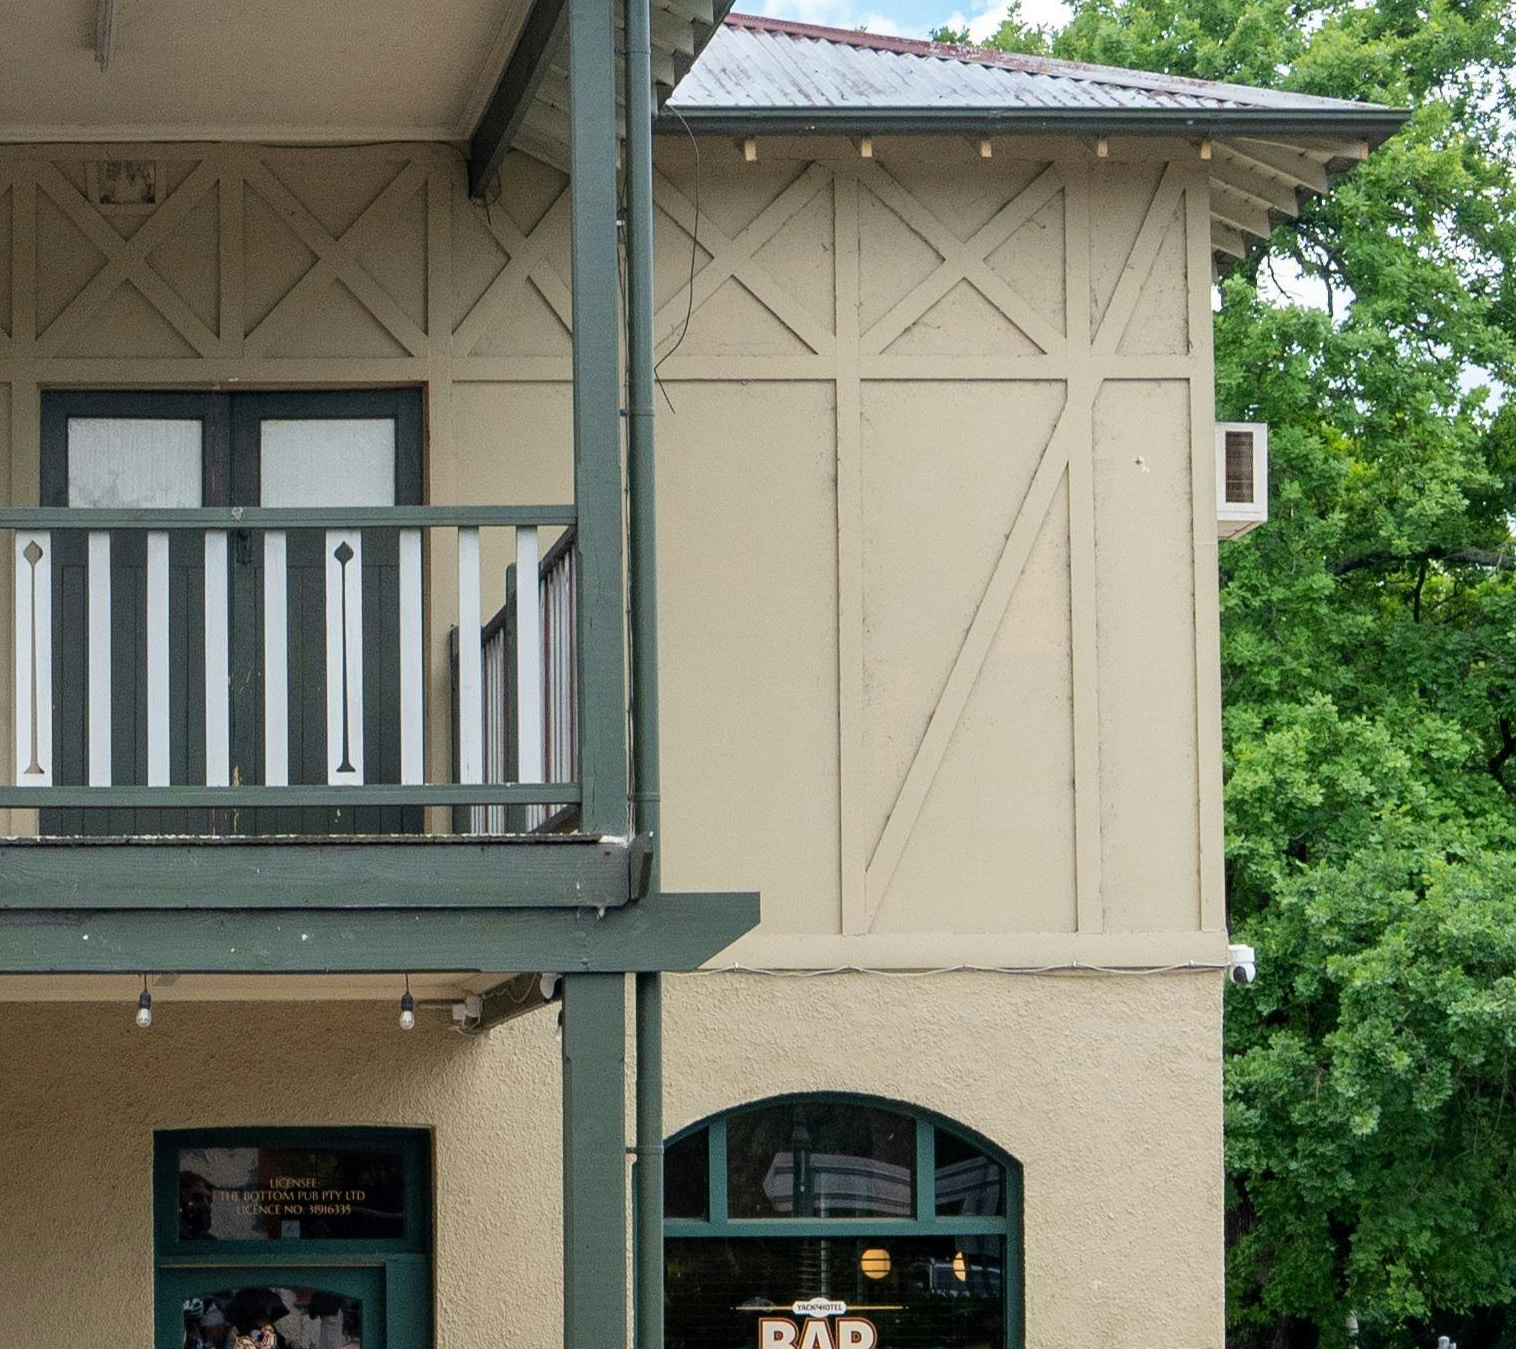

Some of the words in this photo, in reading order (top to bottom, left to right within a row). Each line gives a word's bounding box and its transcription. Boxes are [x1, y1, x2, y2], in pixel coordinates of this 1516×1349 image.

[244, 1191, 295, 1201] BOTTOM
[298, 1191, 318, 1201] PUB
[322, 1191, 342, 1201] PTY
[345, 1191, 366, 1201] LTD
[237, 1205, 280, 1215] LICENCE
